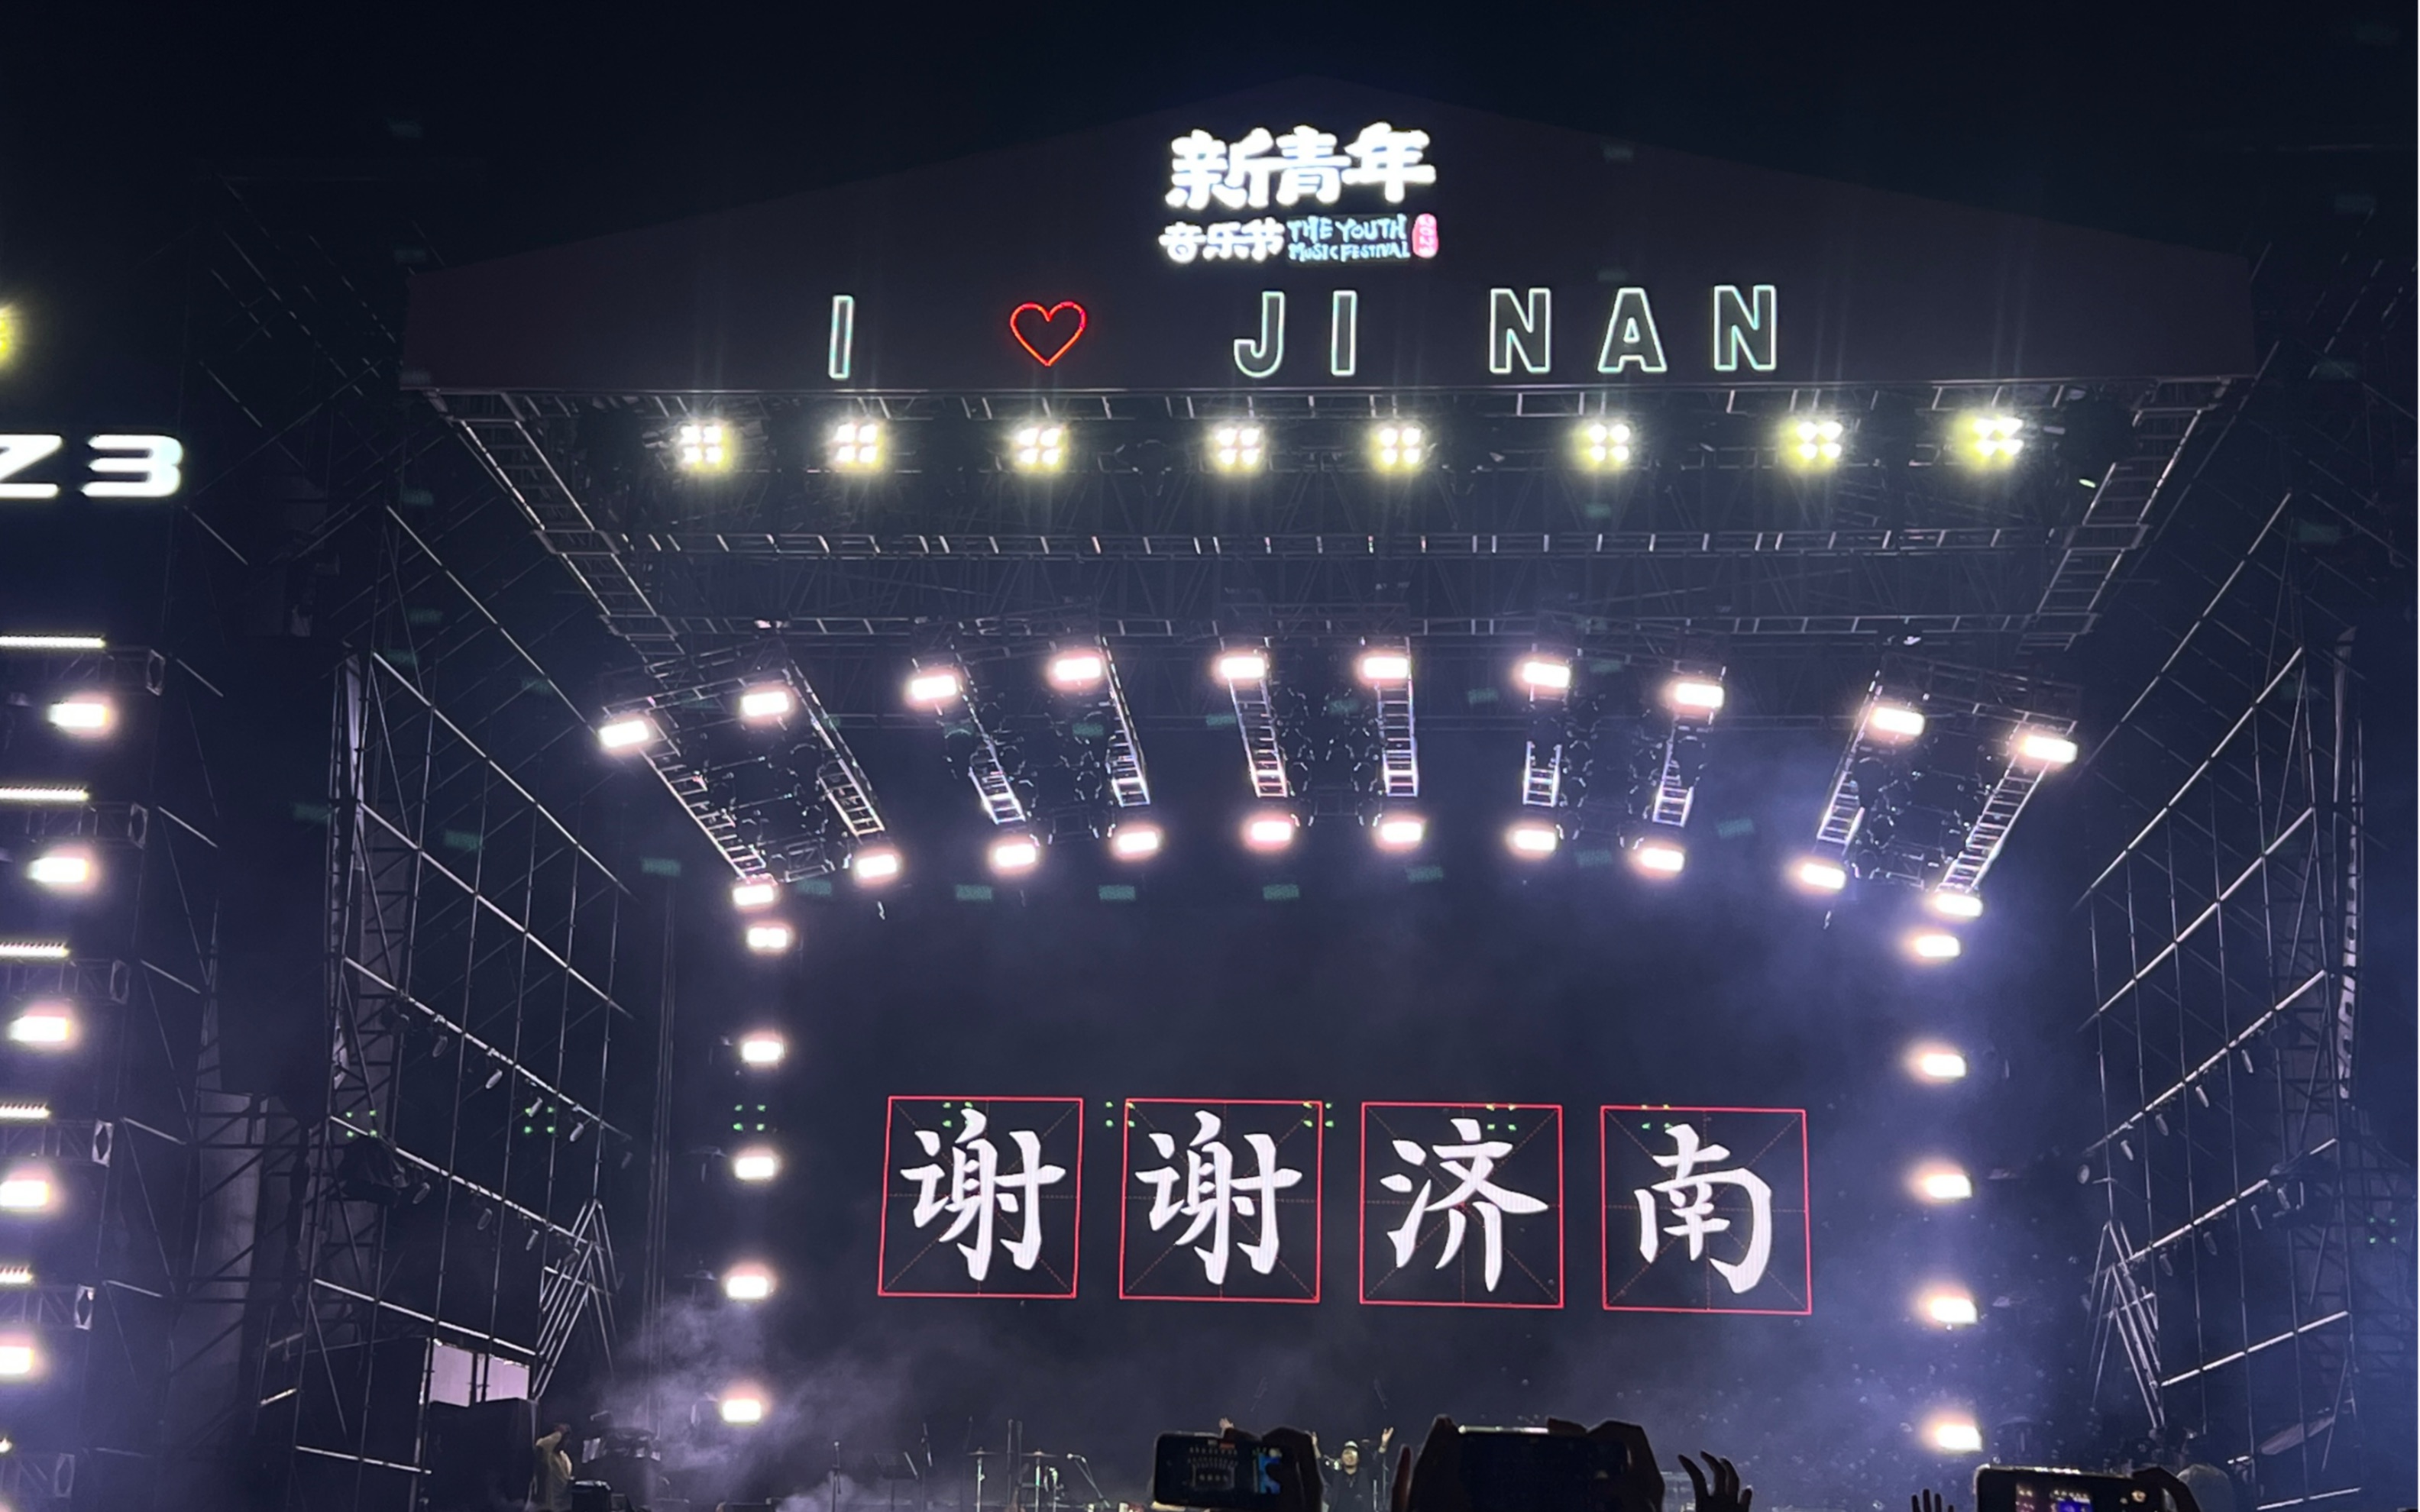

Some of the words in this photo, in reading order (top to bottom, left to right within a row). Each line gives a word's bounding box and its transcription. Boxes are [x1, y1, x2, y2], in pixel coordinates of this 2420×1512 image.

[1165, 121, 1436, 210] 新青年
[1158, 217, 1286, 263] 音乐节
[1286, 215, 1334, 244] THE
[1335, 213, 1408, 243] YOUTH
[1288, 241, 1339, 263] MUSIC
[1341, 241, 1411, 263] FESTIVAL
[829, 295, 854, 379] I
[1489, 285, 1777, 374] NAN
[900, 1108, 1771, 1294] 谢谢济南
